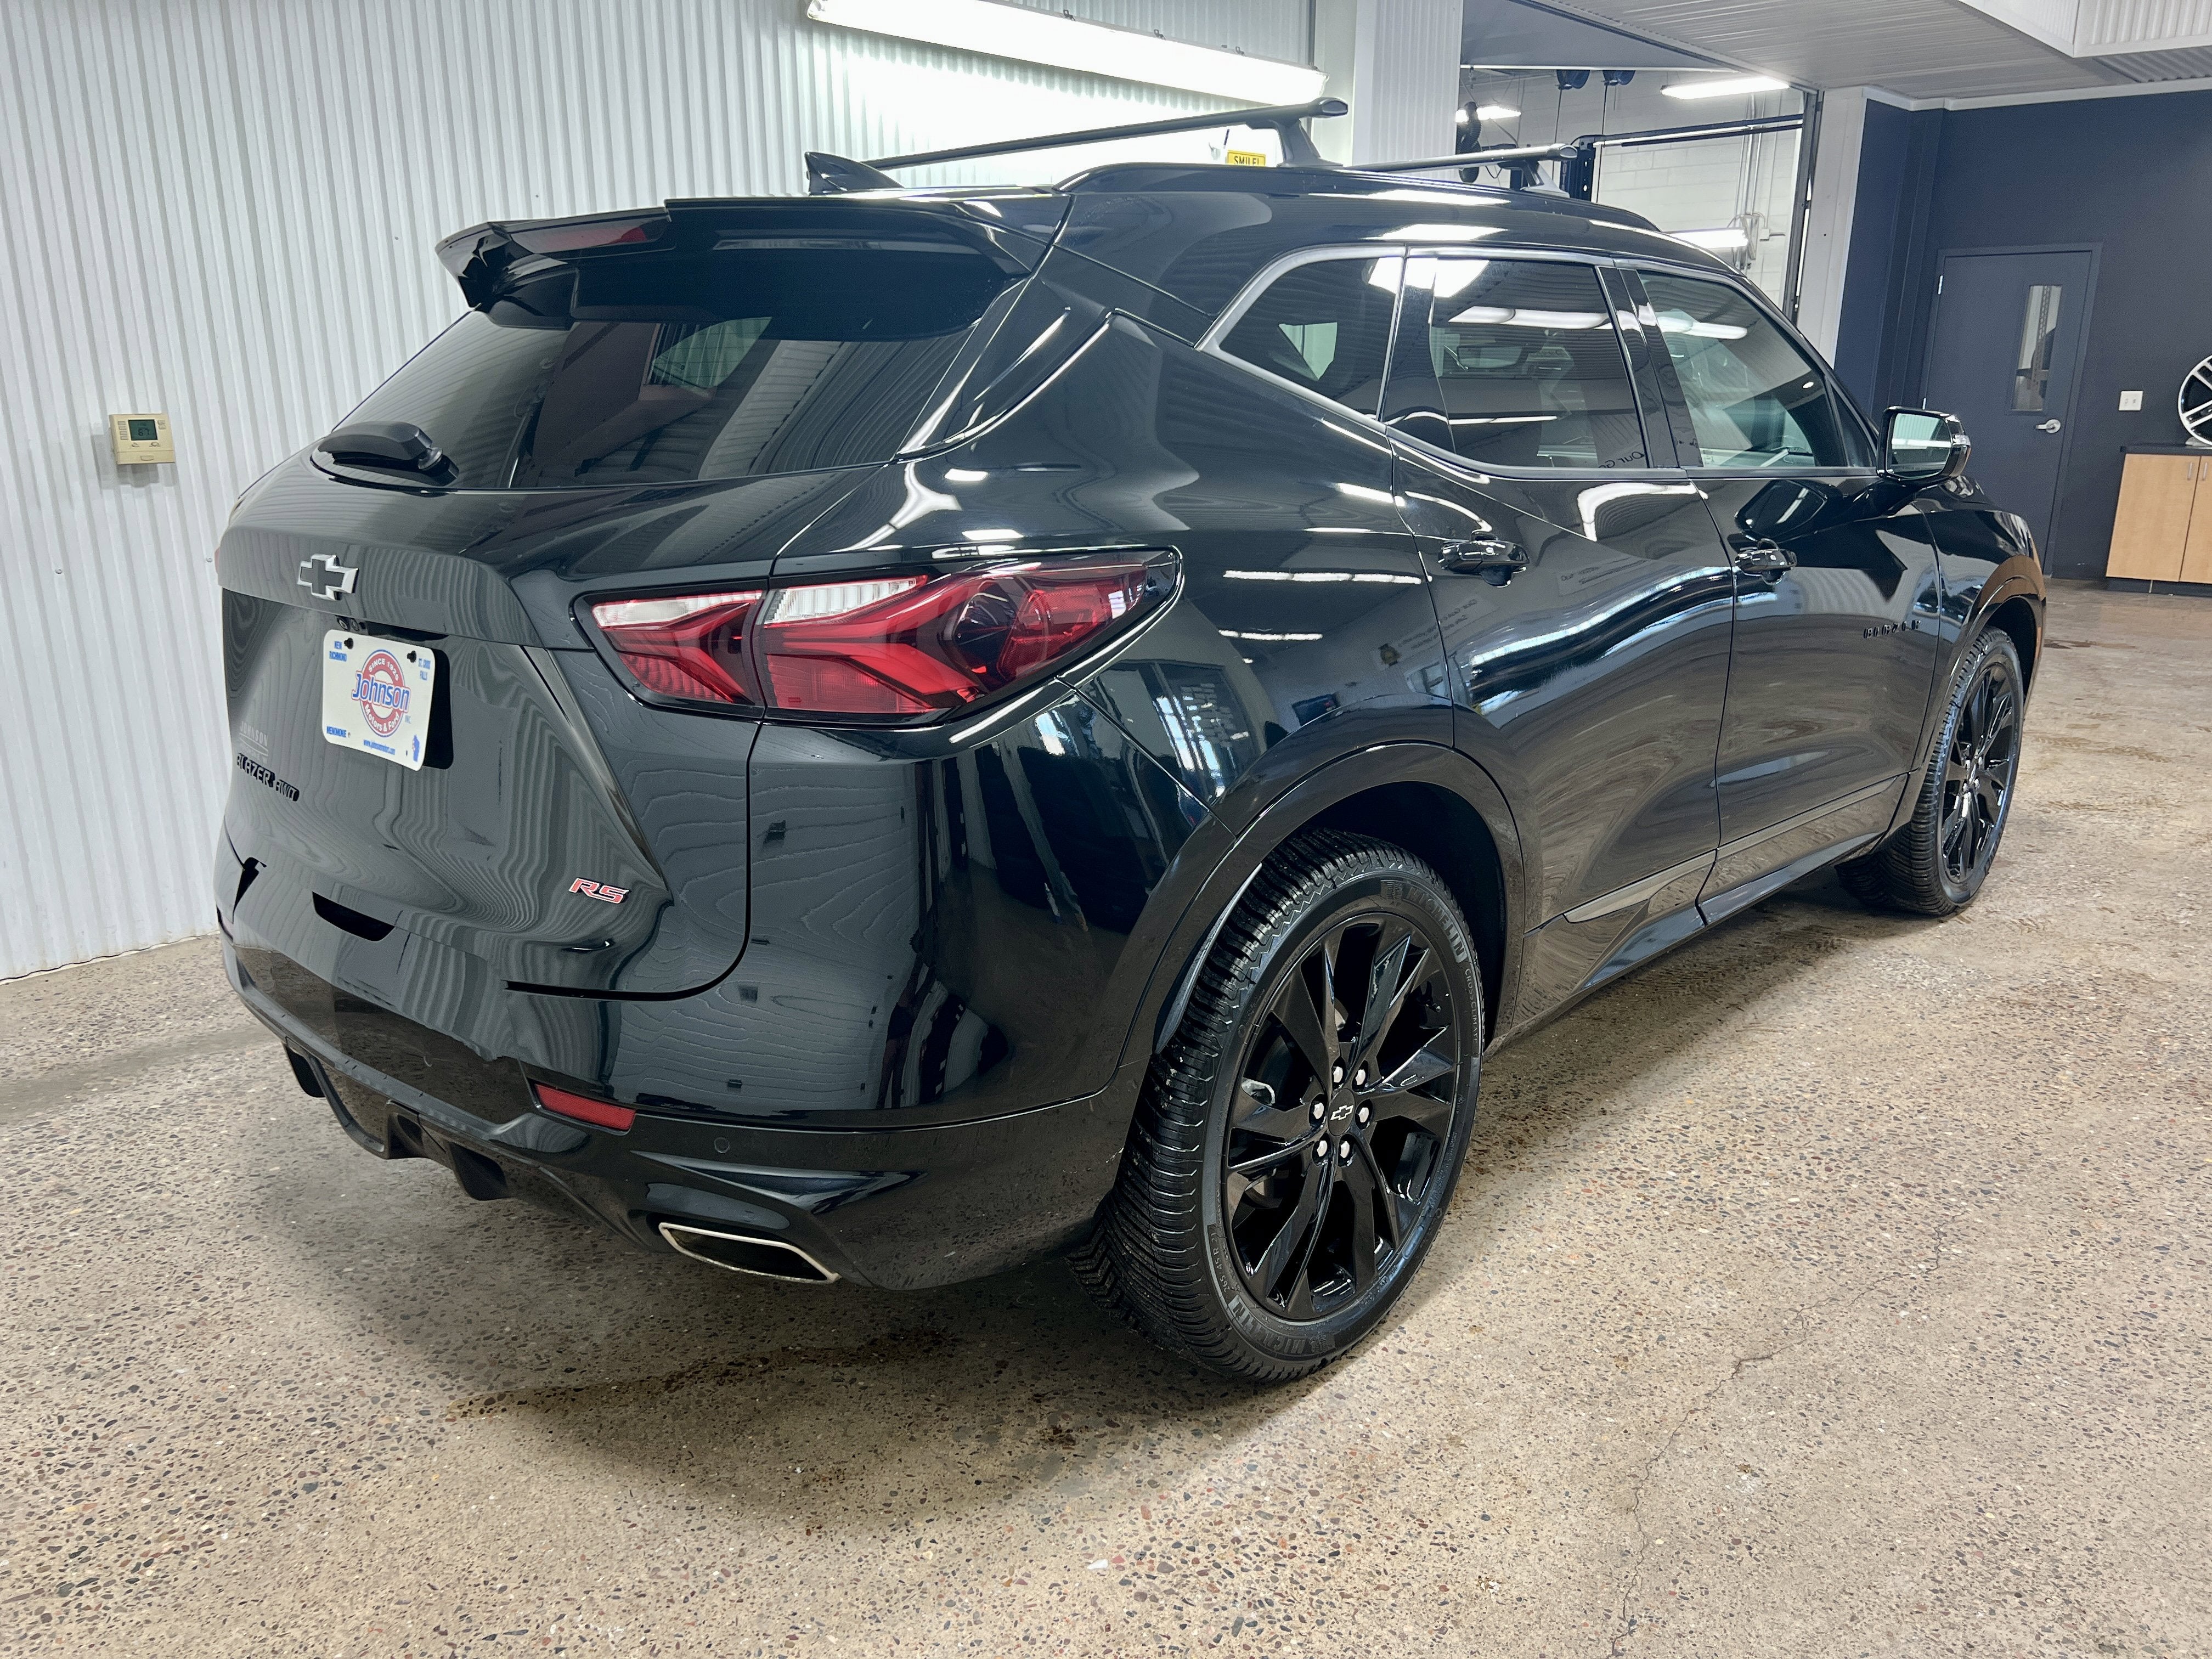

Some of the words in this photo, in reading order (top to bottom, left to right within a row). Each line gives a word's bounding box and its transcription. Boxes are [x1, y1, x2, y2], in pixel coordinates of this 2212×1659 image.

[368, 658, 386, 673] SINCE
[352, 672, 410, 712] Johnson
[364, 703, 382, 731] Motors
[383, 723, 387, 732] &
[388, 712, 399, 731] Ford
[240, 721, 268, 747] JOHNSON
[237, 753, 275, 788] BLAZER
[276, 780, 300, 802] AWD
[569, 878, 629, 904] RS
[1406, 885, 1466, 957] MICHELIN
